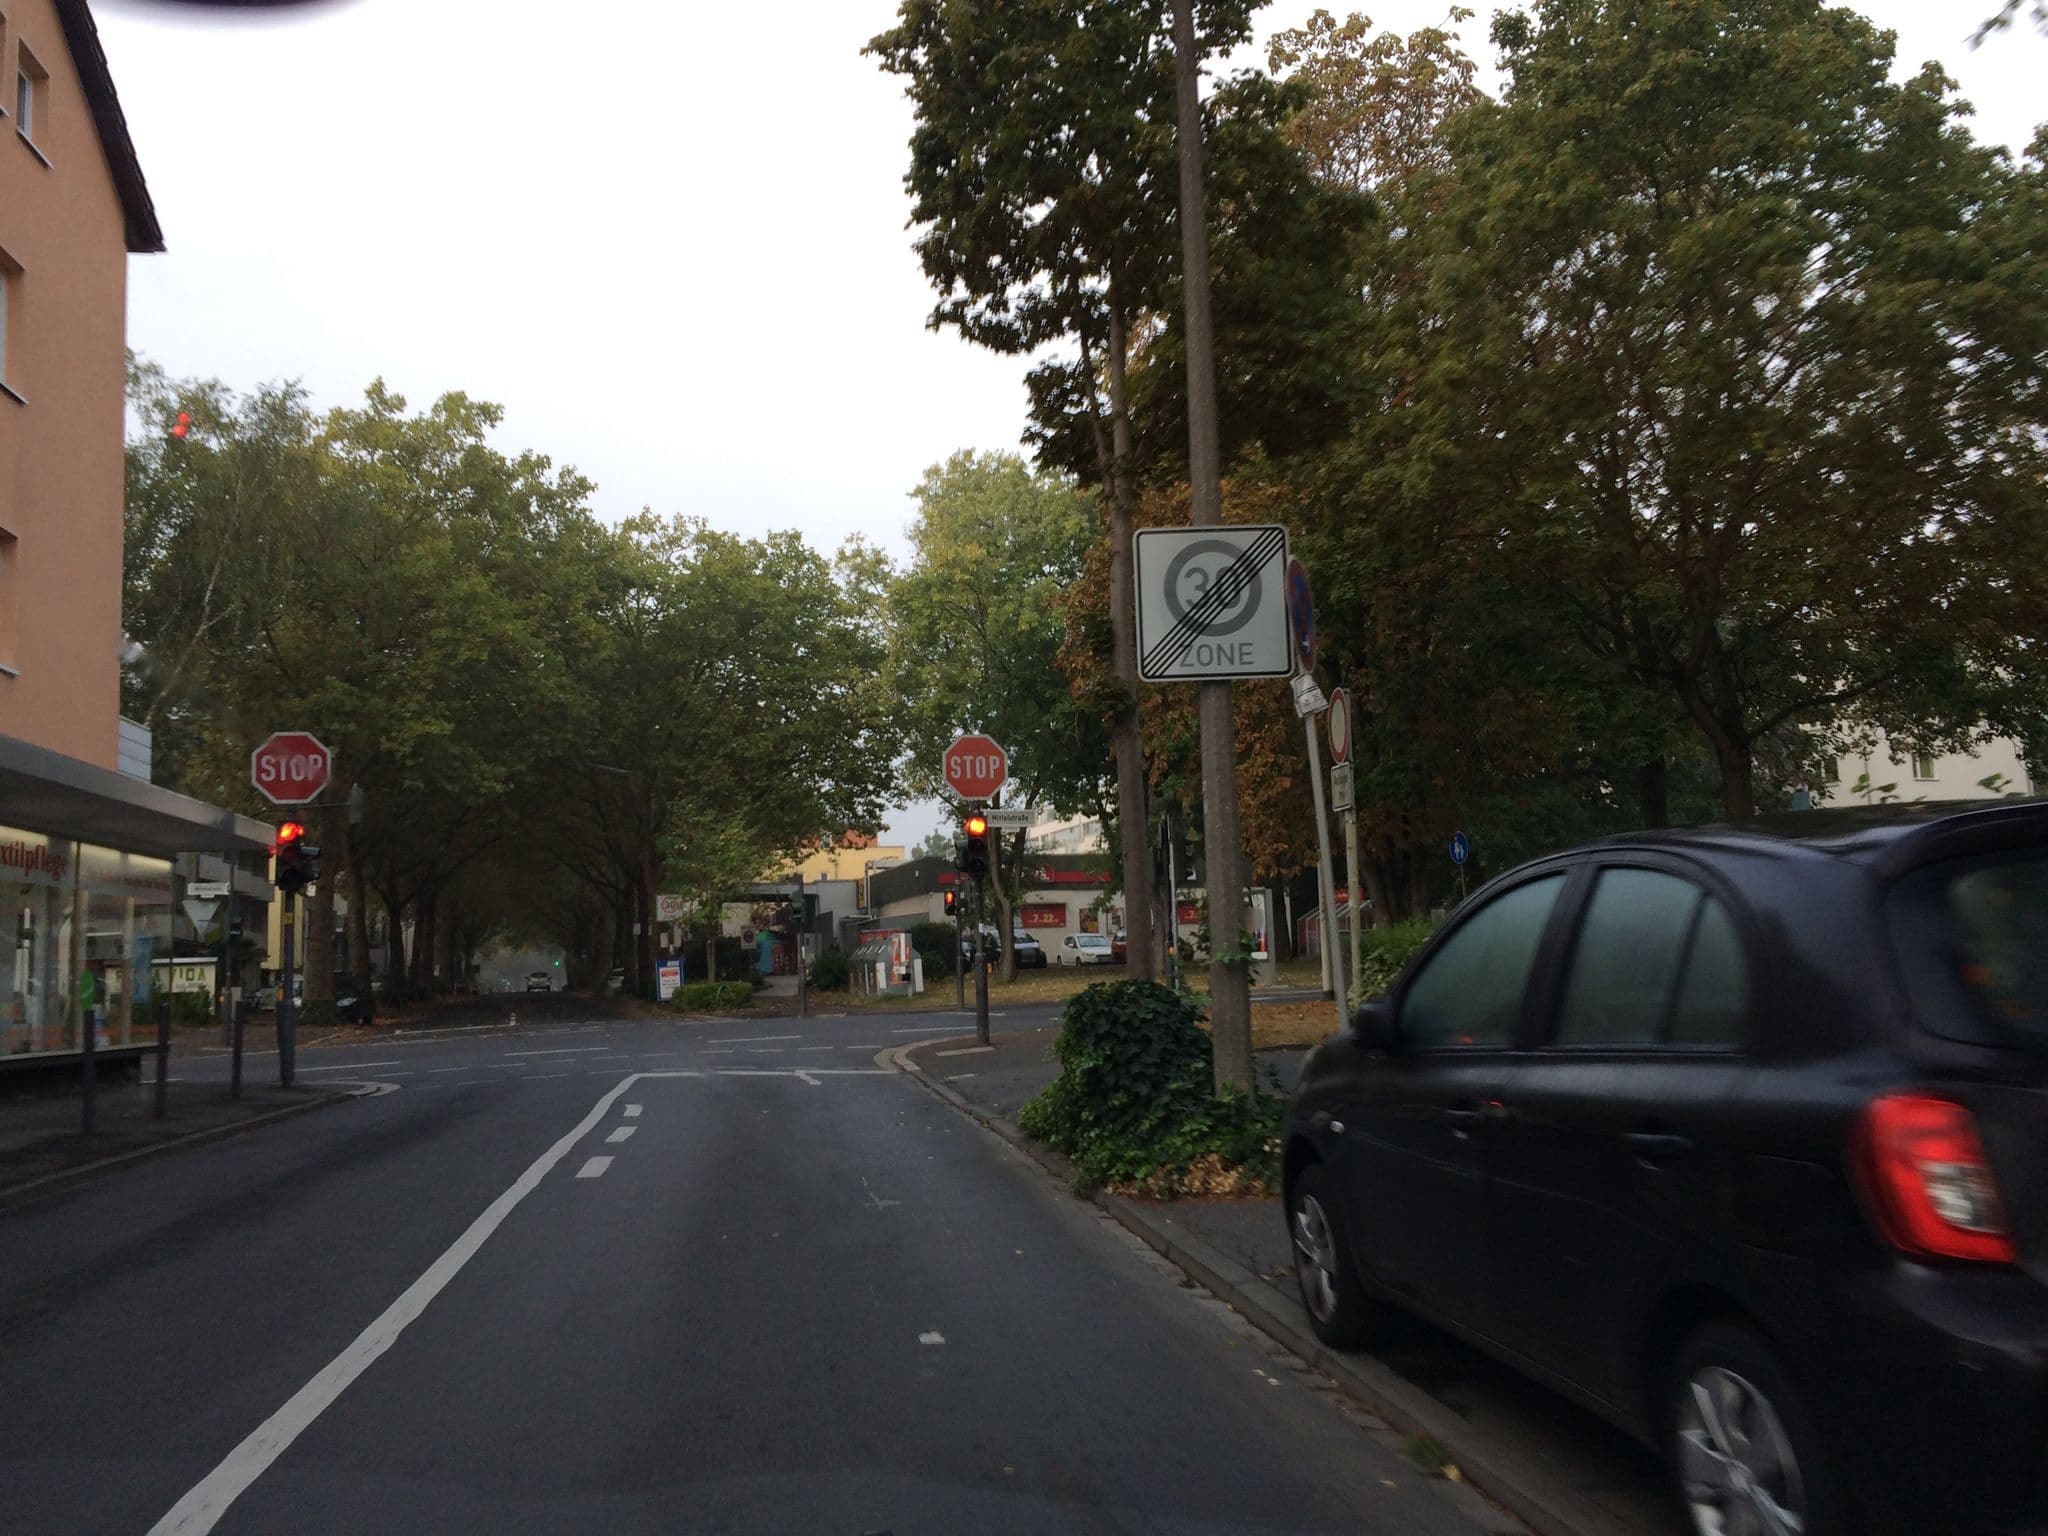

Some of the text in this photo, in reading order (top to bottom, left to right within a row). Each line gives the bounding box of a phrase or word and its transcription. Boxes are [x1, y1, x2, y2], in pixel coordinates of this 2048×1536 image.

[1184, 566, 1240, 610] 30
[1179, 642, 1255, 668] ZONE
[261, 754, 324, 782] STOP
[950, 754, 1000, 780] STOP
